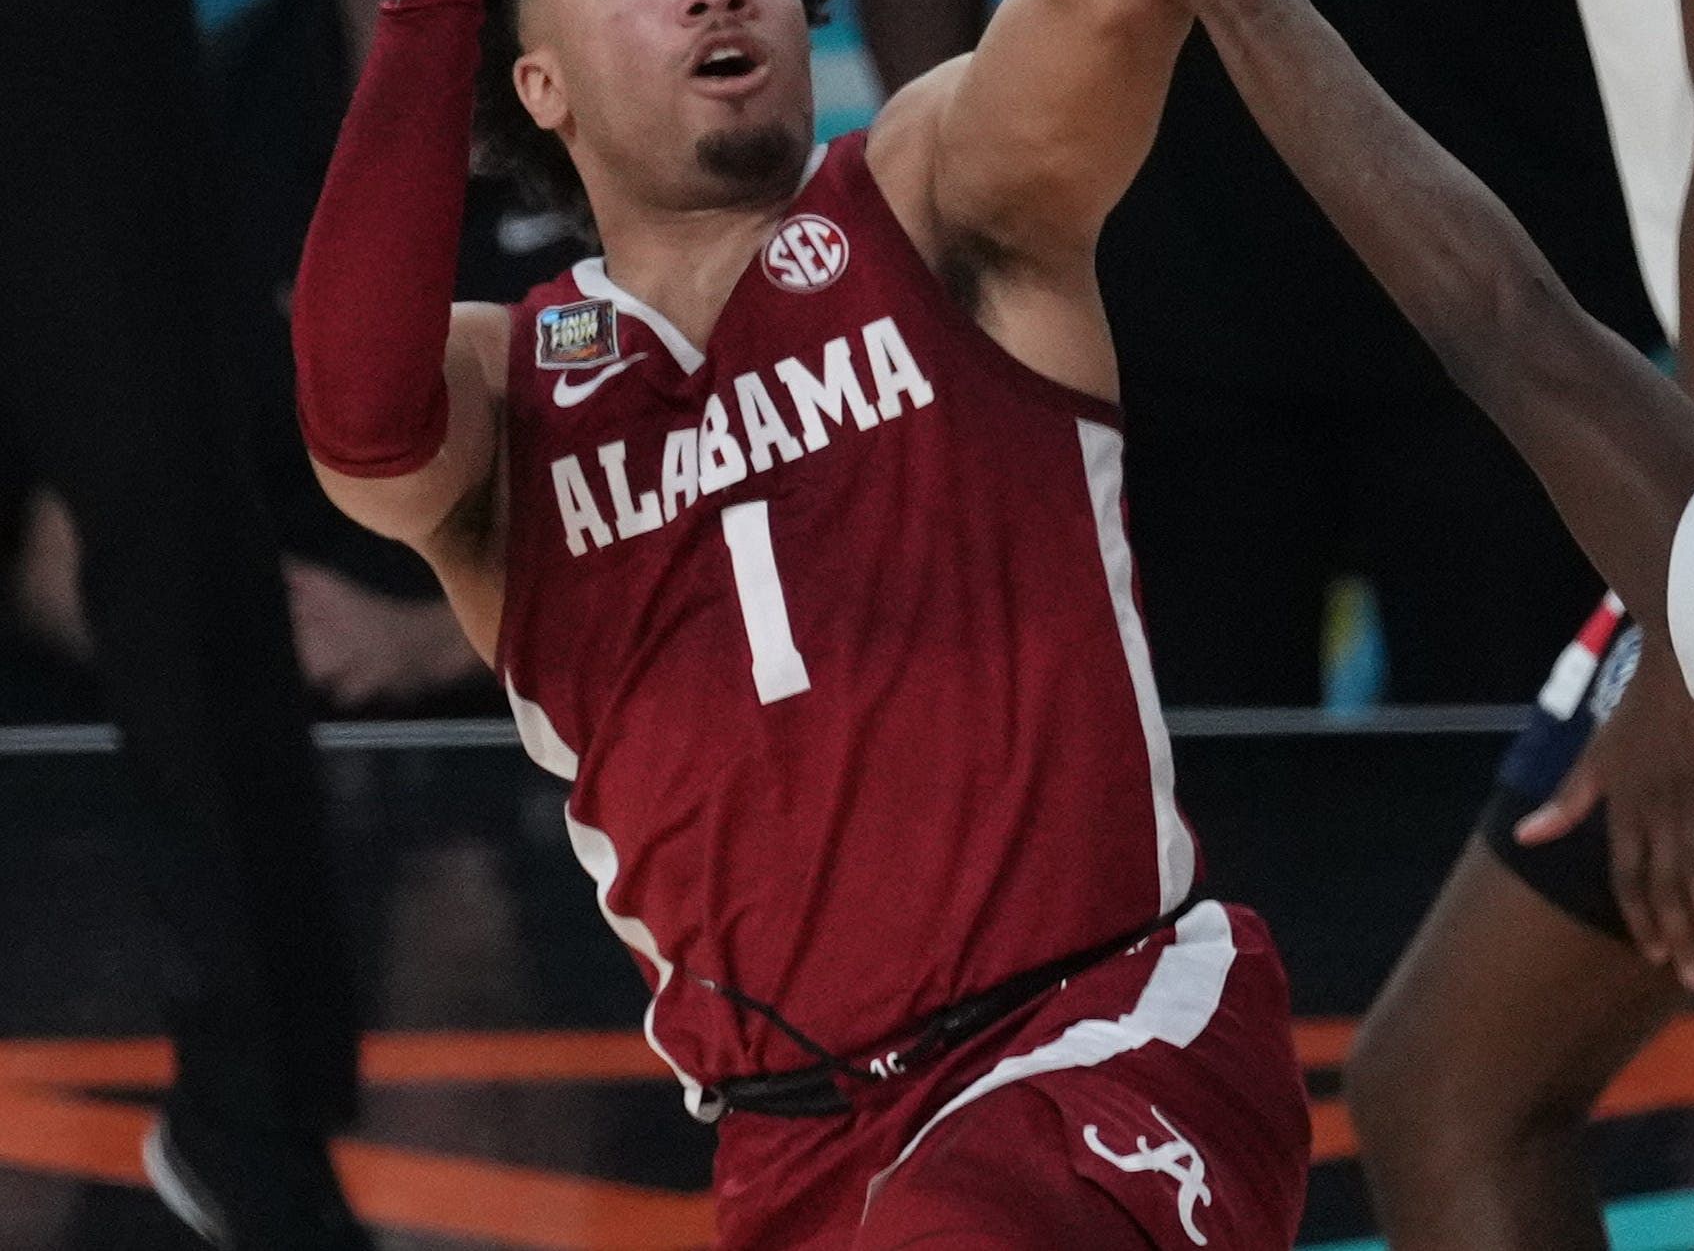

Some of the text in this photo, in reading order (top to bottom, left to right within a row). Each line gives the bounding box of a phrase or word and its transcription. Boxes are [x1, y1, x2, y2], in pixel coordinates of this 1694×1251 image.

[768, 220, 842, 286] SEC
[550, 315, 935, 558] ALABAMA
[719, 499, 812, 706] 1
